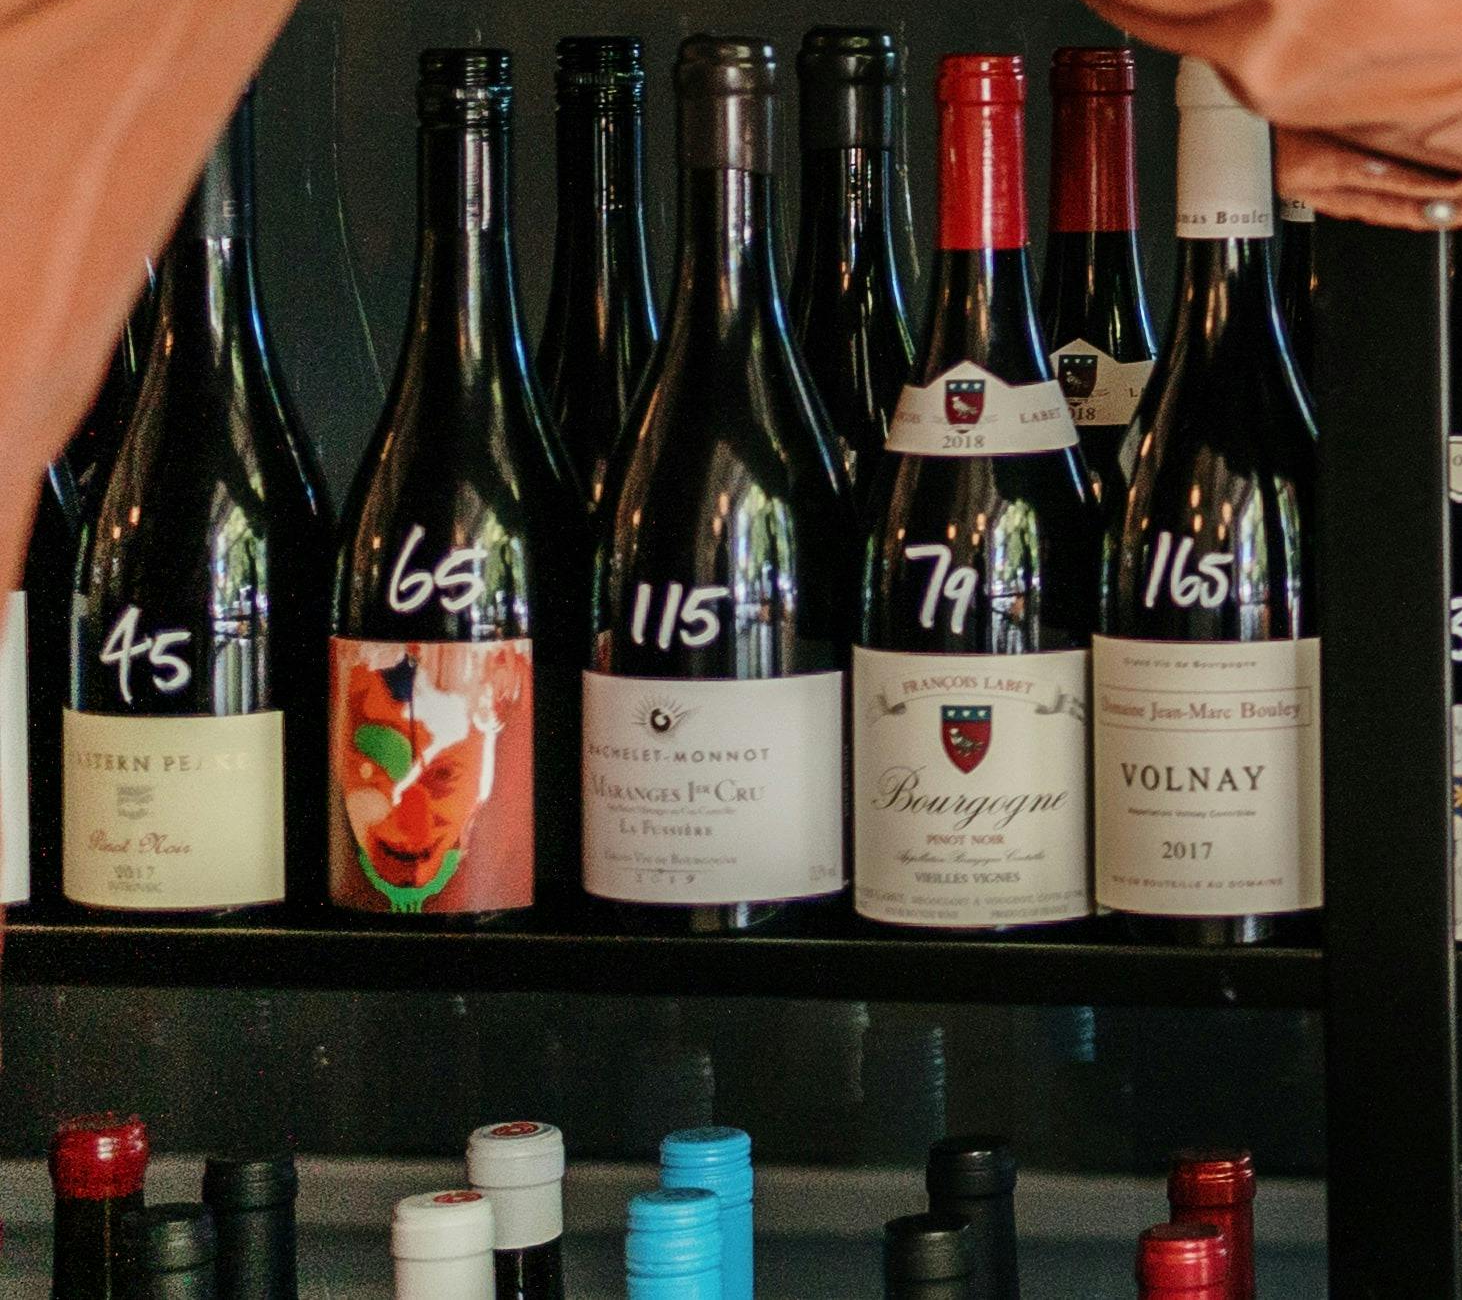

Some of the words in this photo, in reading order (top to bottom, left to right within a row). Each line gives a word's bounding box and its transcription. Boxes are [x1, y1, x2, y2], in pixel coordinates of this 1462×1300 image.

[941, 432, 985, 450] 2018
[387, 523, 490, 614] 65
[906, 545, 978, 635] 79
[1145, 531, 1235, 609] 165
[631, 582, 729, 650] 115
[100, 607, 192, 704] 45
[872, 766, 1070, 831] Bourgogne
[1121, 762, 1267, 793] VOLNAY
[926, 831, 965, 847] PINOT
[970, 832, 1006, 847] NOIR
[1161, 840, 1215, 862] 2017
